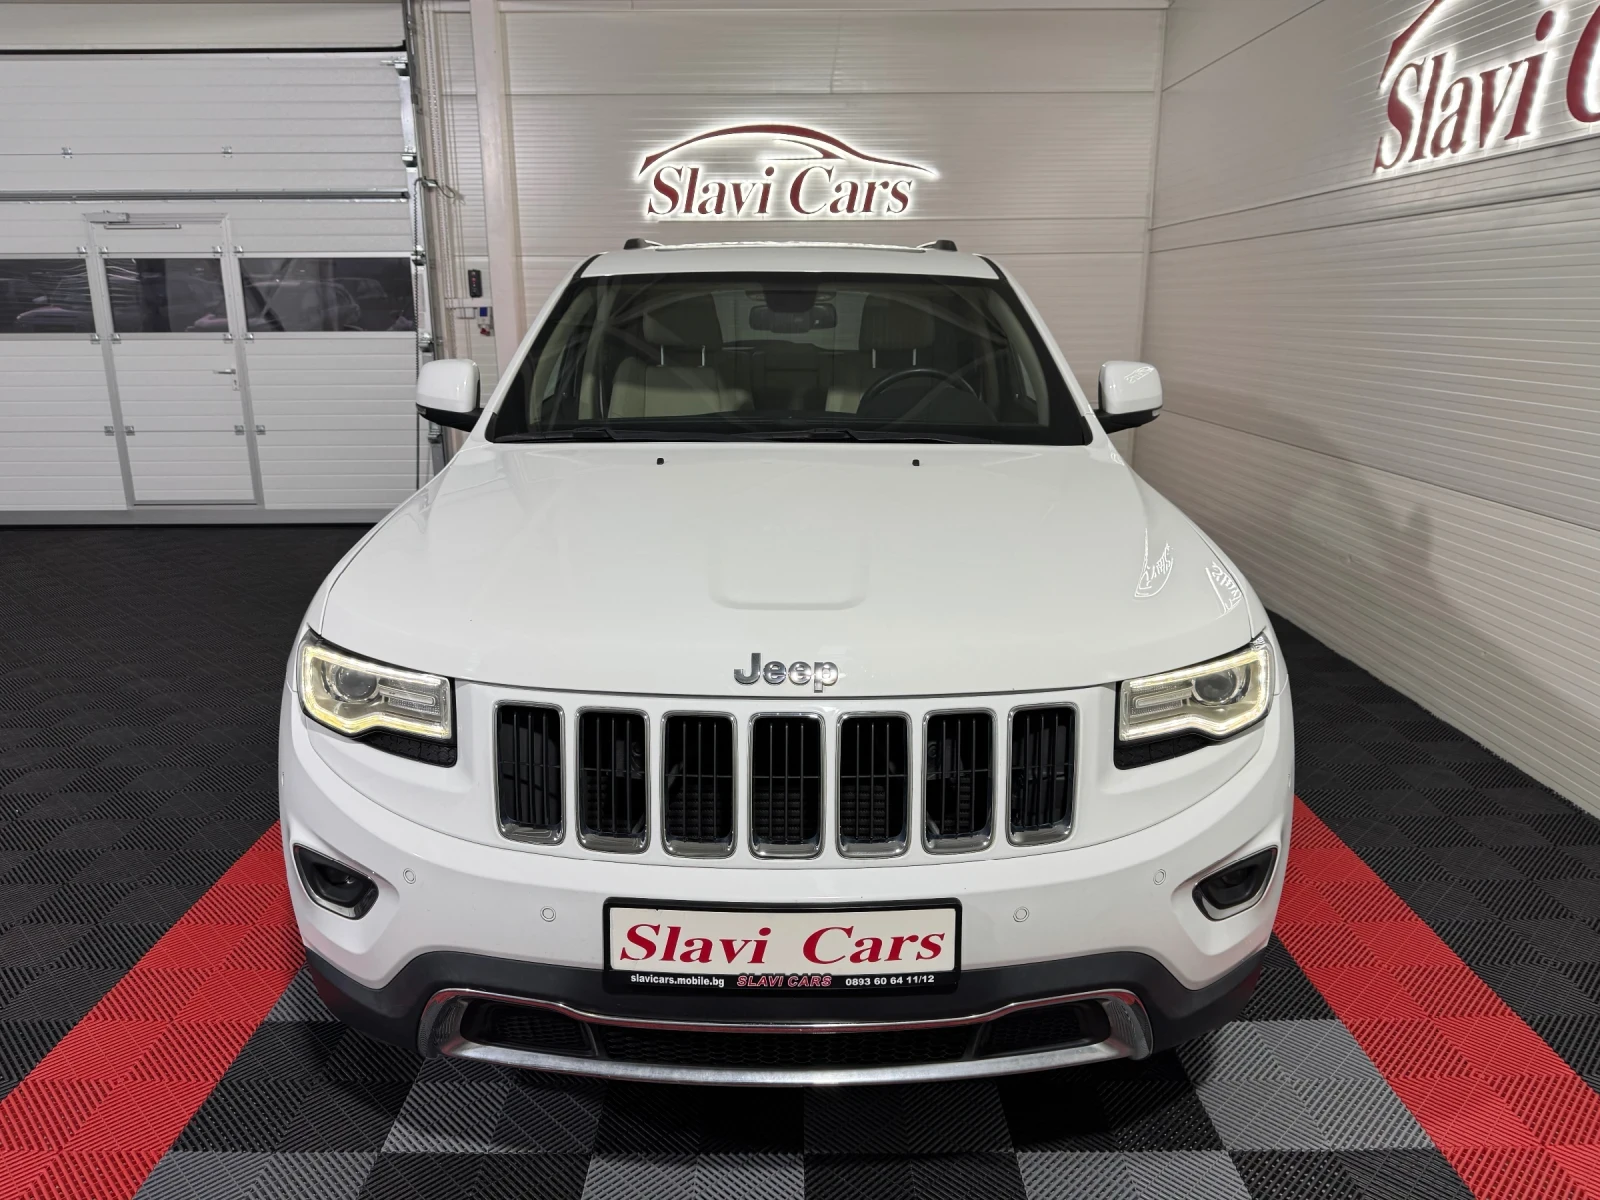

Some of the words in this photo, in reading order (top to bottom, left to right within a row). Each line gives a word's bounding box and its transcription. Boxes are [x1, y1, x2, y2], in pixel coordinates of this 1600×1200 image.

[1372, 9, 1556, 174] Slavi
[647, 165, 775, 215] Slavi
[789, 165, 913, 215] Cars
[733, 652, 839, 693] Jeep
[619, 923, 772, 964] Slavi
[802, 925, 946, 965] Cars
[630, 973, 725, 988] slavicars.mobile.bg
[736, 975, 784, 987] SLAVI
[787, 975, 832, 987] CARS
[845, 977, 871, 986] 0893
[874, 977, 887, 985] 60
[890, 976, 903, 985] 64
[906, 975, 935, 984] 11/12
